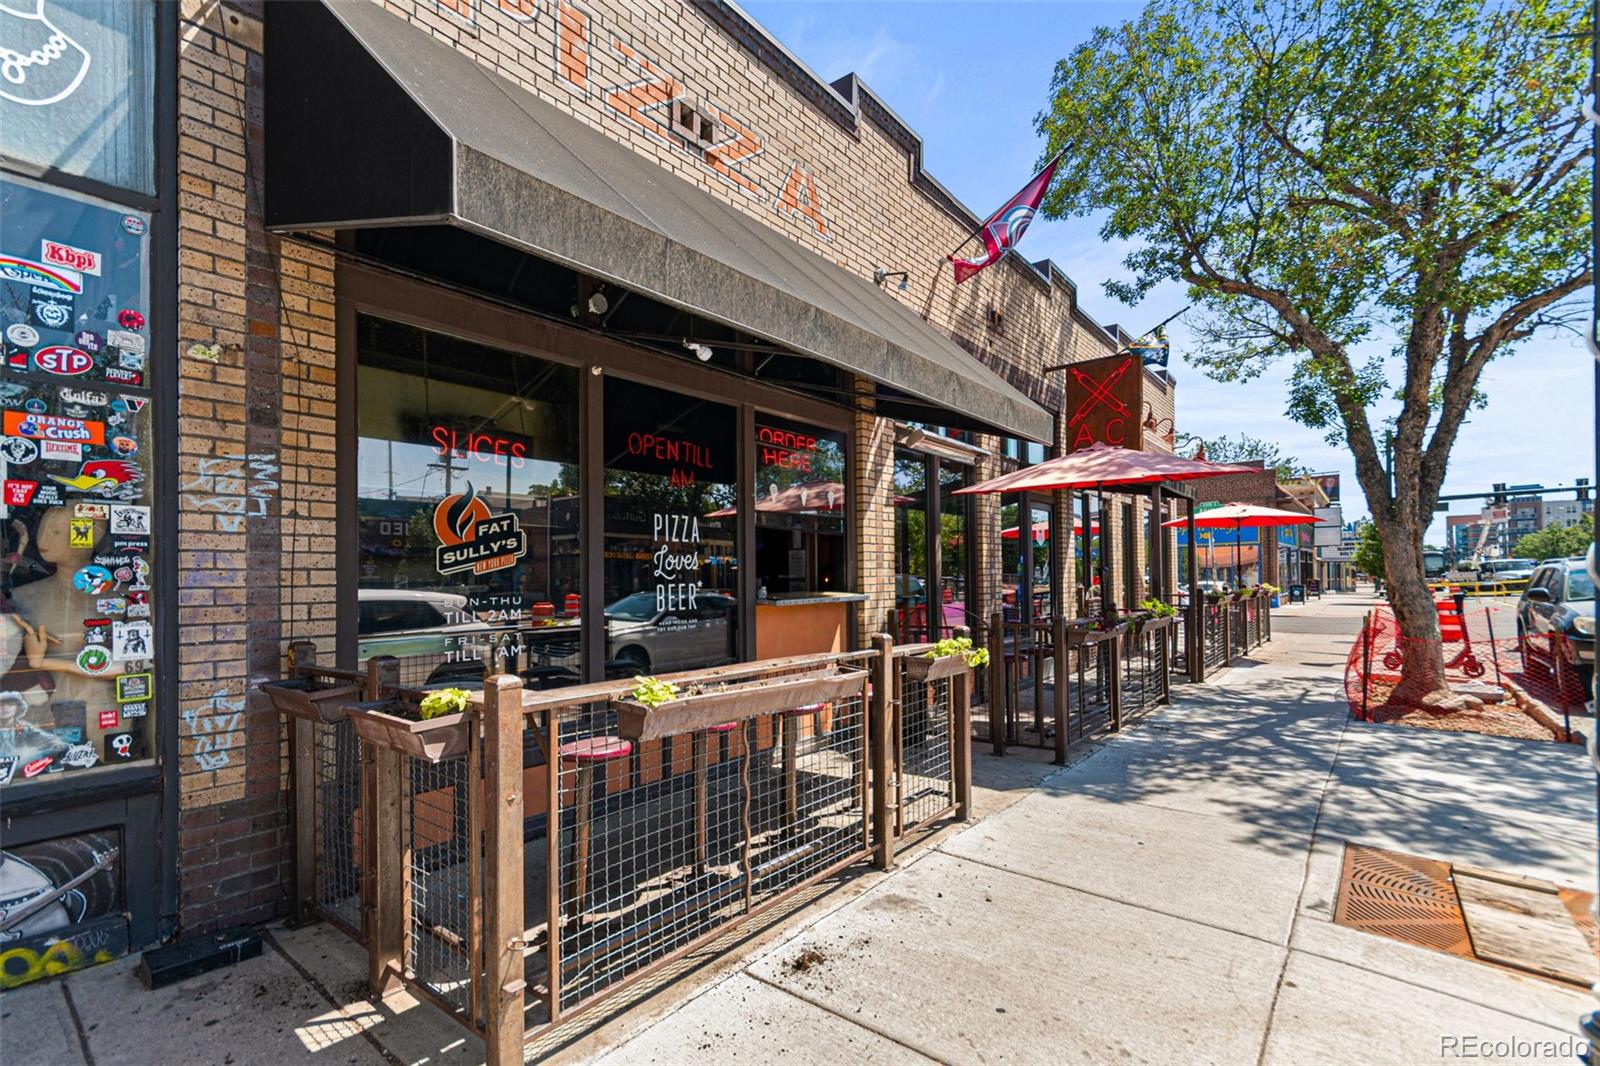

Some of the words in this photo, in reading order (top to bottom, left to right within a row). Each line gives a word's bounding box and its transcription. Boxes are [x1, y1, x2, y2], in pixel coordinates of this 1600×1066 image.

[42, 349, 88, 371] STP
[26, 414, 84, 429] ORANGE
[45, 426, 91, 439] Crush
[432, 425, 528, 469] SLICES
[628, 432, 680, 462] OPEN
[681, 440, 714, 469] TILL
[759, 428, 817, 454] ORDER
[763, 448, 812, 473] HERE
[669, 468, 696, 489] AM
[478, 520, 511, 537] FAT
[653, 513, 700, 543] PIZZA
[442, 538, 518, 564] SULLY'S
[654, 544, 699, 580] Loves
[443, 611, 481, 625] TILL
[488, 608, 522, 622] 2AM
[444, 632, 522, 647] FRI-SAT
[443, 649, 482, 664] TILL
[498, 645, 522, 658] AM
